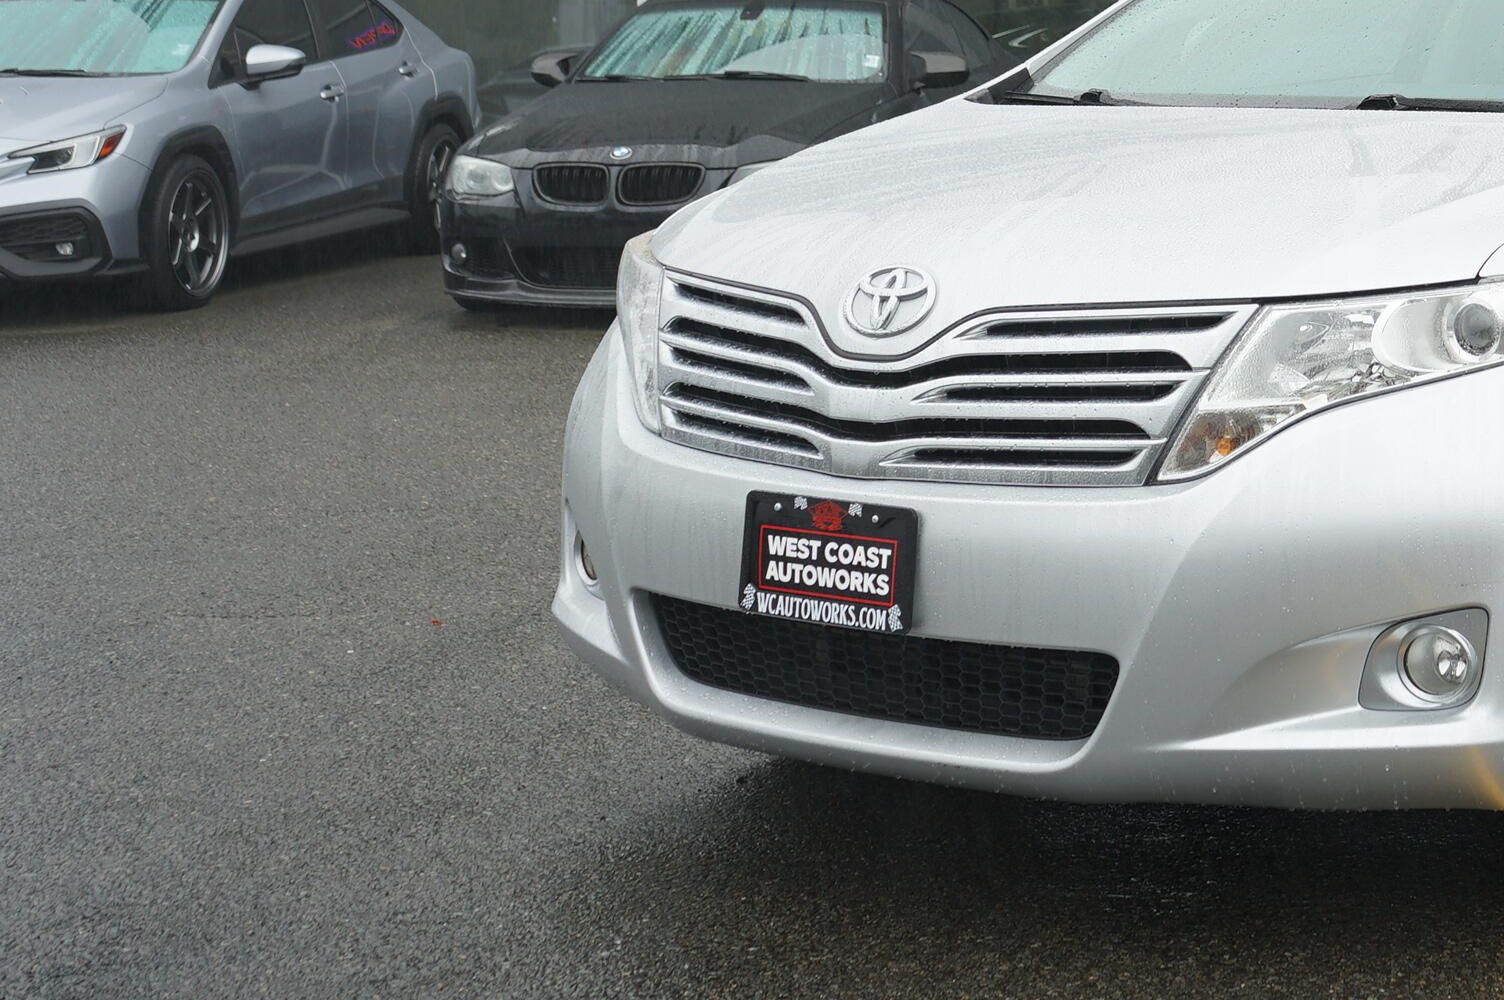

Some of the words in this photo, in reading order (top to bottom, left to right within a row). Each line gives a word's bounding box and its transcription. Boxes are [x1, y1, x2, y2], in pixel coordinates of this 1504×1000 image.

[767, 534, 821, 561] WEST
[824, 541, 892, 570] COAST
[765, 560, 890, 596] AUTOWORKS
[756, 591, 887, 631] WCAUTOWORKS.COM
